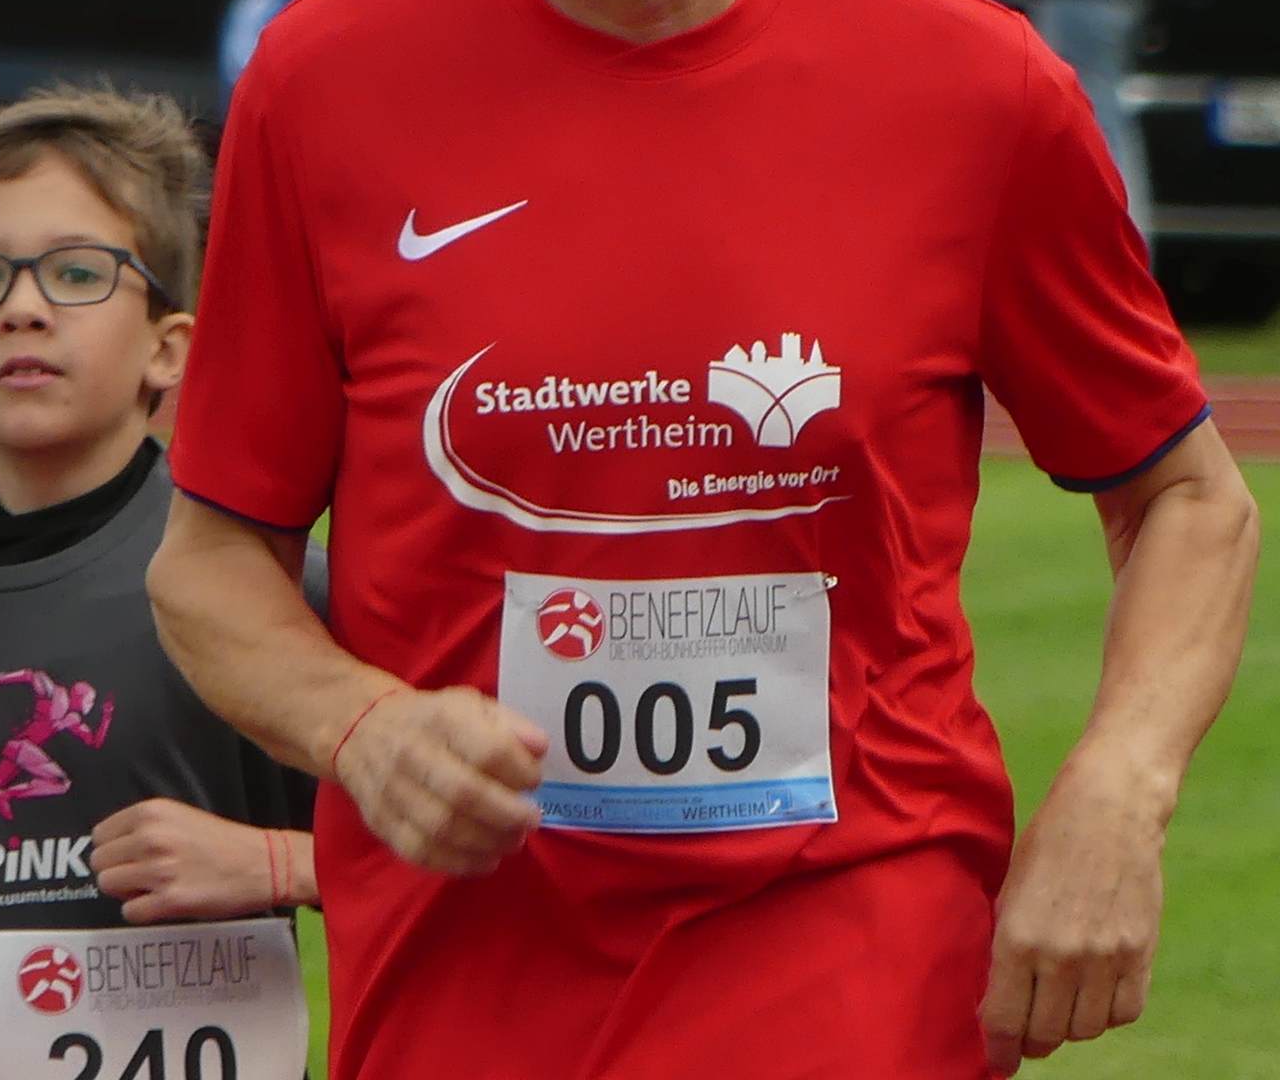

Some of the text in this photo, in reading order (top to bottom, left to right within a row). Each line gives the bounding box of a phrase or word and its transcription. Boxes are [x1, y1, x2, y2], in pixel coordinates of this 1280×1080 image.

[475, 371, 691, 415] Stadtwerke
[547, 415, 733, 454] Wertheim
[668, 465, 840, 500] Die Energie vor Ort
[609, 584, 787, 641] BENEFIZLAUF
[563, 677, 761, 776] 005
[681, 800, 766, 821] WERTHEIM
[86, 935, 257, 993] BENEFIZLAUF
